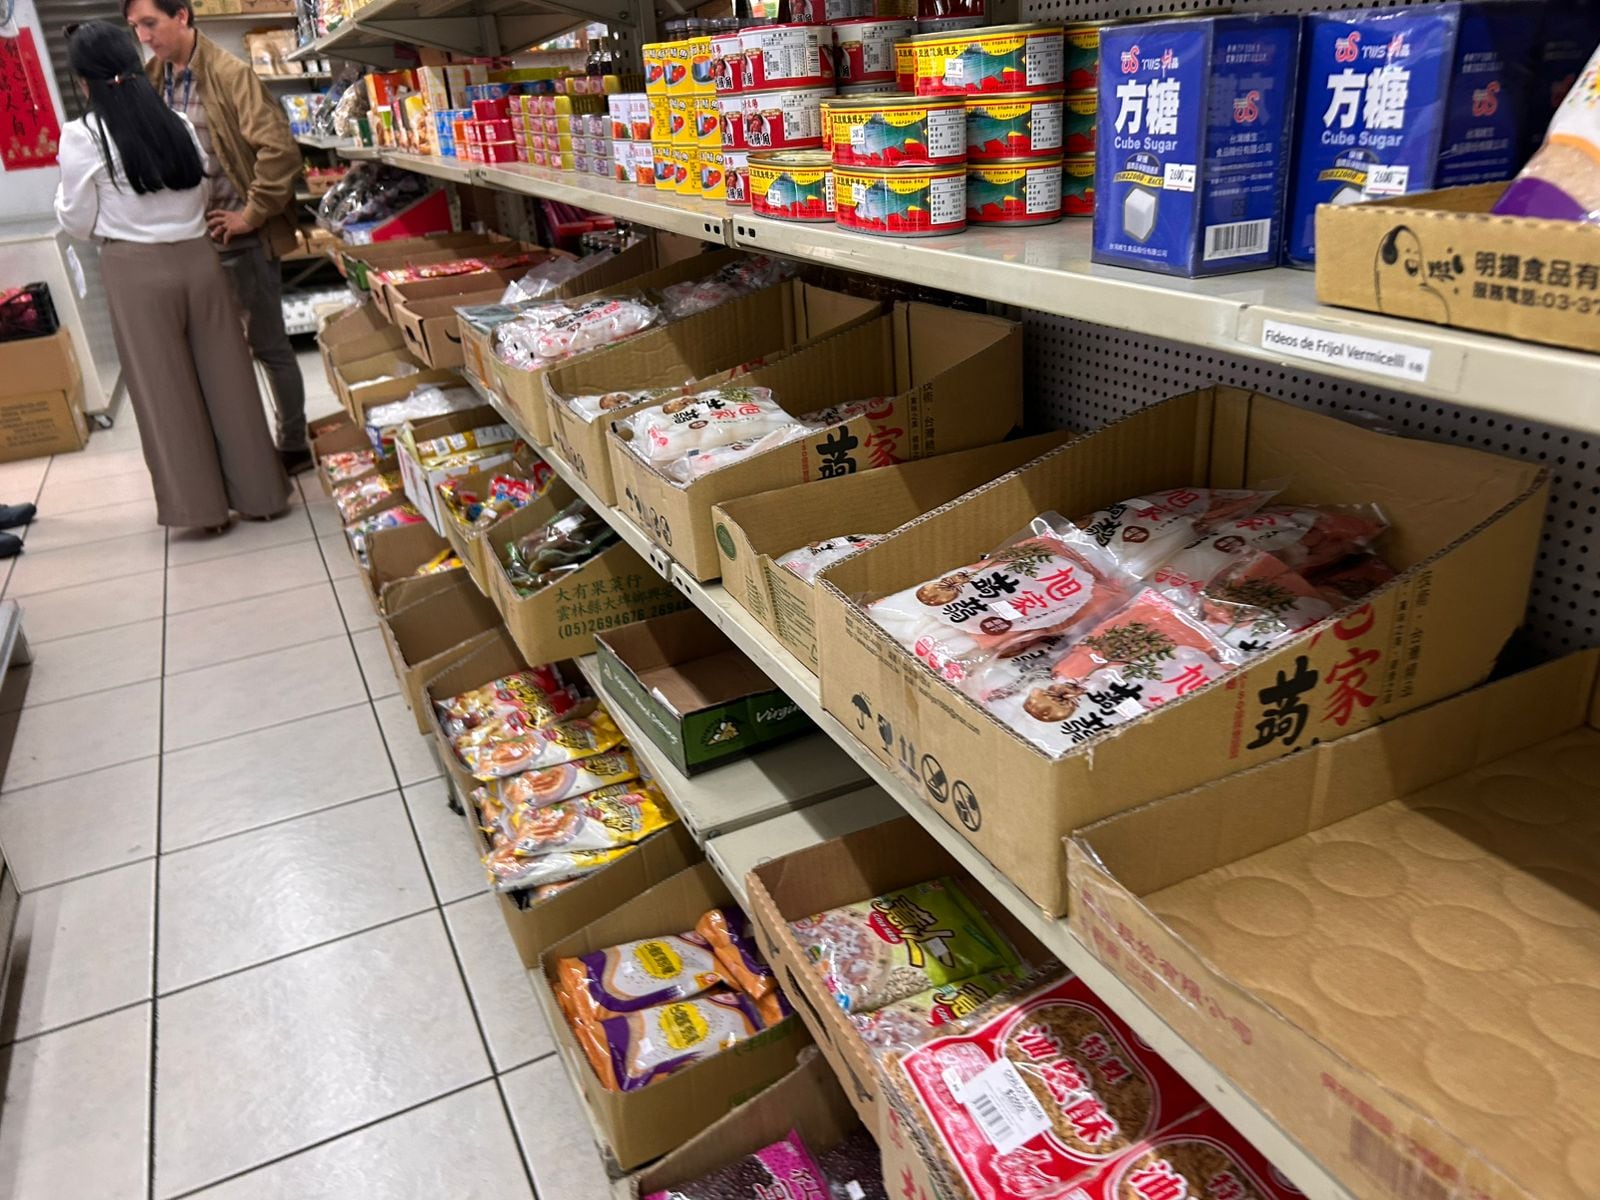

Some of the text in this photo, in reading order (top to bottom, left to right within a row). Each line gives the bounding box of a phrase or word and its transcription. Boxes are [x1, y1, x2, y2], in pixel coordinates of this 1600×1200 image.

[1115, 78, 1181, 135] 方糖
[1323, 67, 1411, 130] 方糖
[1114, 136, 1178, 154] Cube Sugar
[1321, 130, 1404, 149] Cube Sugar
[1265, 329, 1298, 348] Fideos
[1300, 336, 1315, 351] de
[1316, 339, 1345, 358] Frijol
[1347, 345, 1406, 368] Vermicelli
[943, 571, 1020, 623] 蒟蒻
[1009, 566, 1083, 616] 旭家
